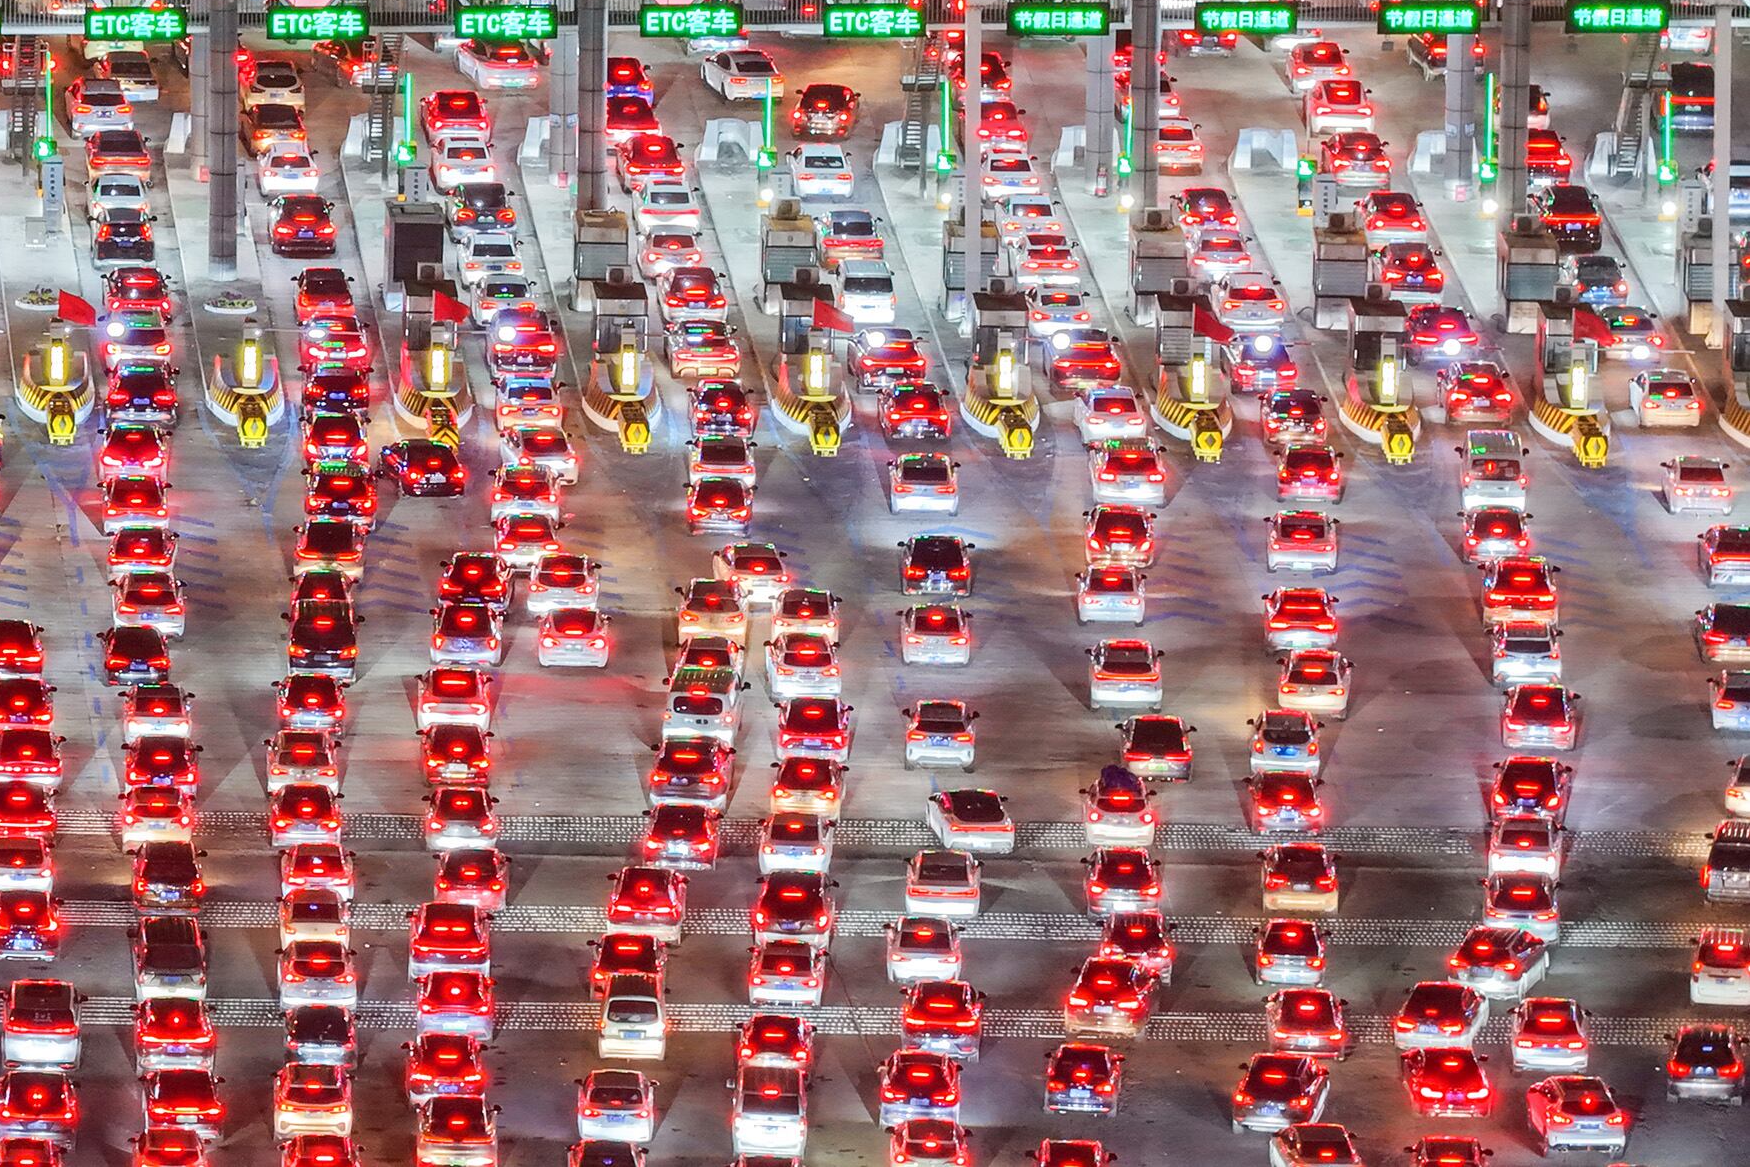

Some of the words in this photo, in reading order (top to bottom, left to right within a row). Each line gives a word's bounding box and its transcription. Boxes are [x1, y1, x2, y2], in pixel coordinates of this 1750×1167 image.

[90, 11, 182, 37] ETC客车
[272, 10, 364, 36] ETC客车
[461, 10, 552, 36] ETC客车
[646, 10, 737, 36] ETC客车
[829, 9, 921, 35] ETC客车
[1015, 10, 1103, 30] 节假日通道
[1202, 10, 1290, 29] 节假日通道
[1385, 9, 1473, 28] 节假日通道
[1573, 8, 1662, 27] 节假日通道
